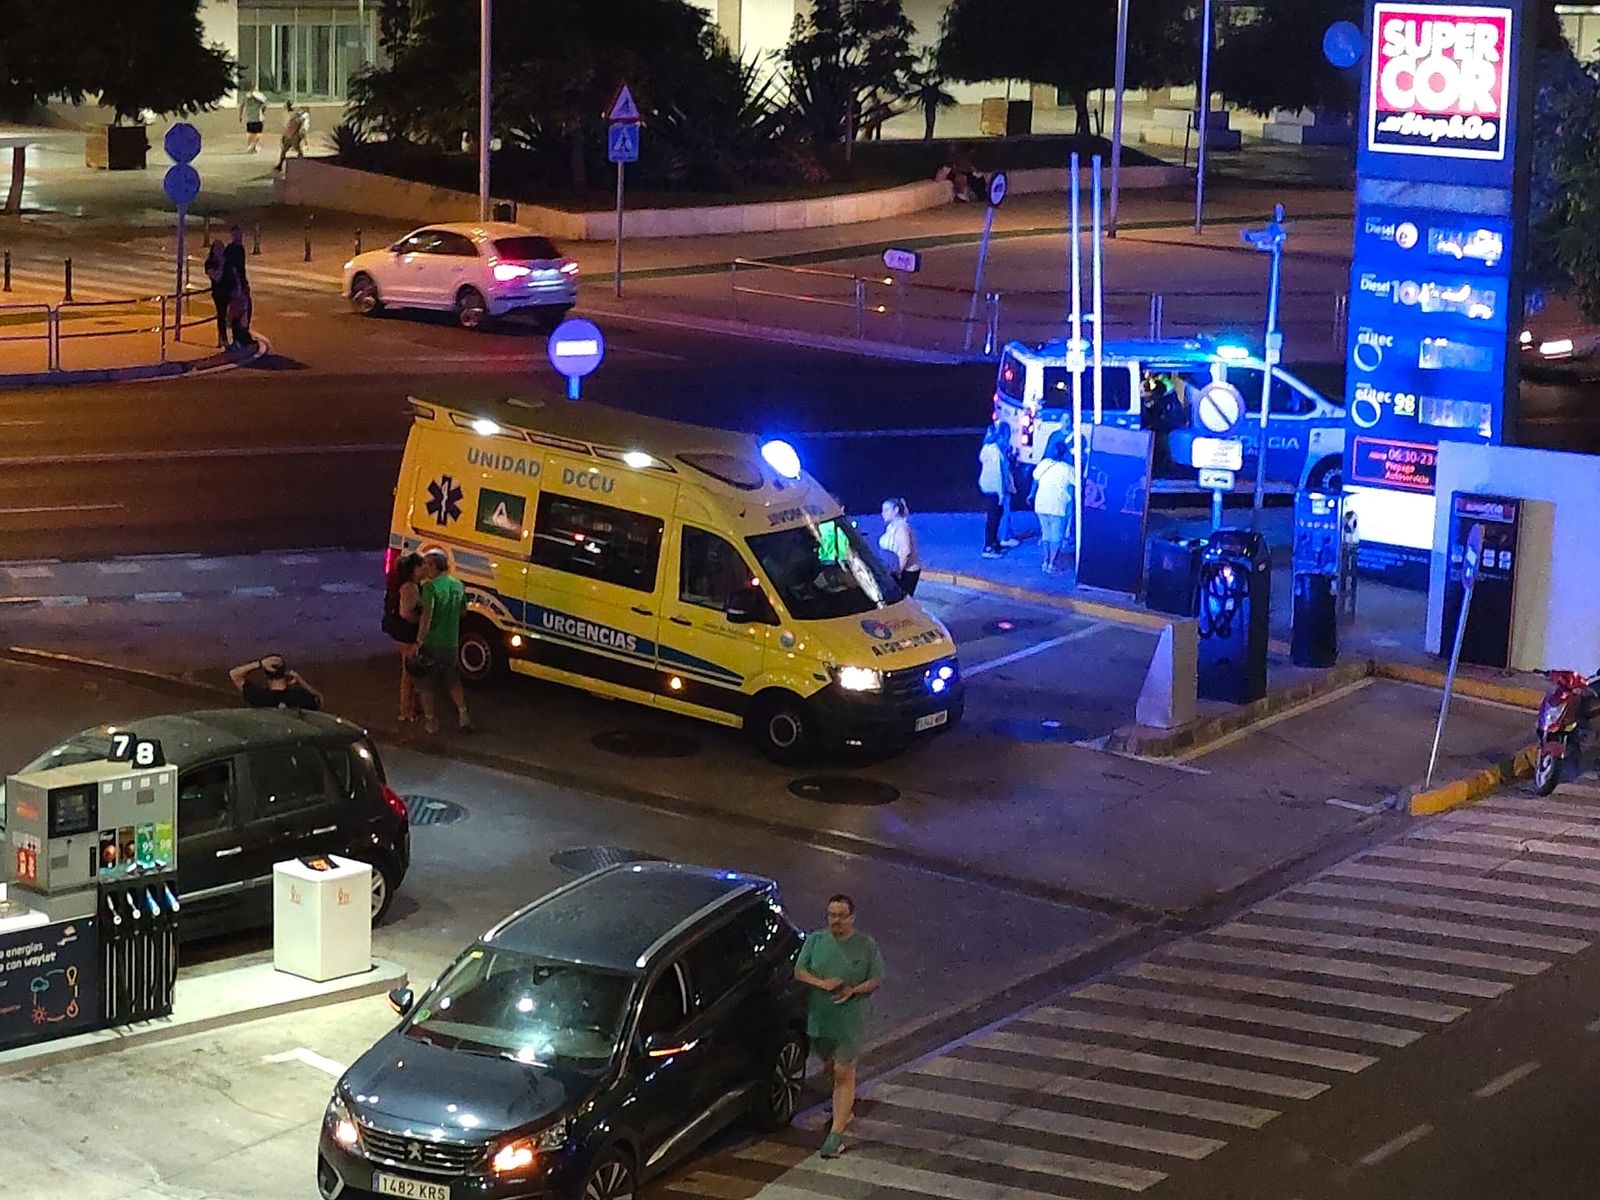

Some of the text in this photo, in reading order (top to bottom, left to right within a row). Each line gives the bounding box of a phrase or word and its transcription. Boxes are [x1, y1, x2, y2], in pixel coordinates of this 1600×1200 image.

[1382, 18, 1501, 62] SUPER
[1380, 55, 1498, 112] COR
[1394, 392, 1416, 414] 98
[467, 447, 615, 493] UNIDAD DCCU
[542, 612, 638, 651] URGENCIAS
[113, 735, 130, 757] 7
[136, 742, 154, 765] 8
[382, 1177, 446, 1200] 1482 KRS
